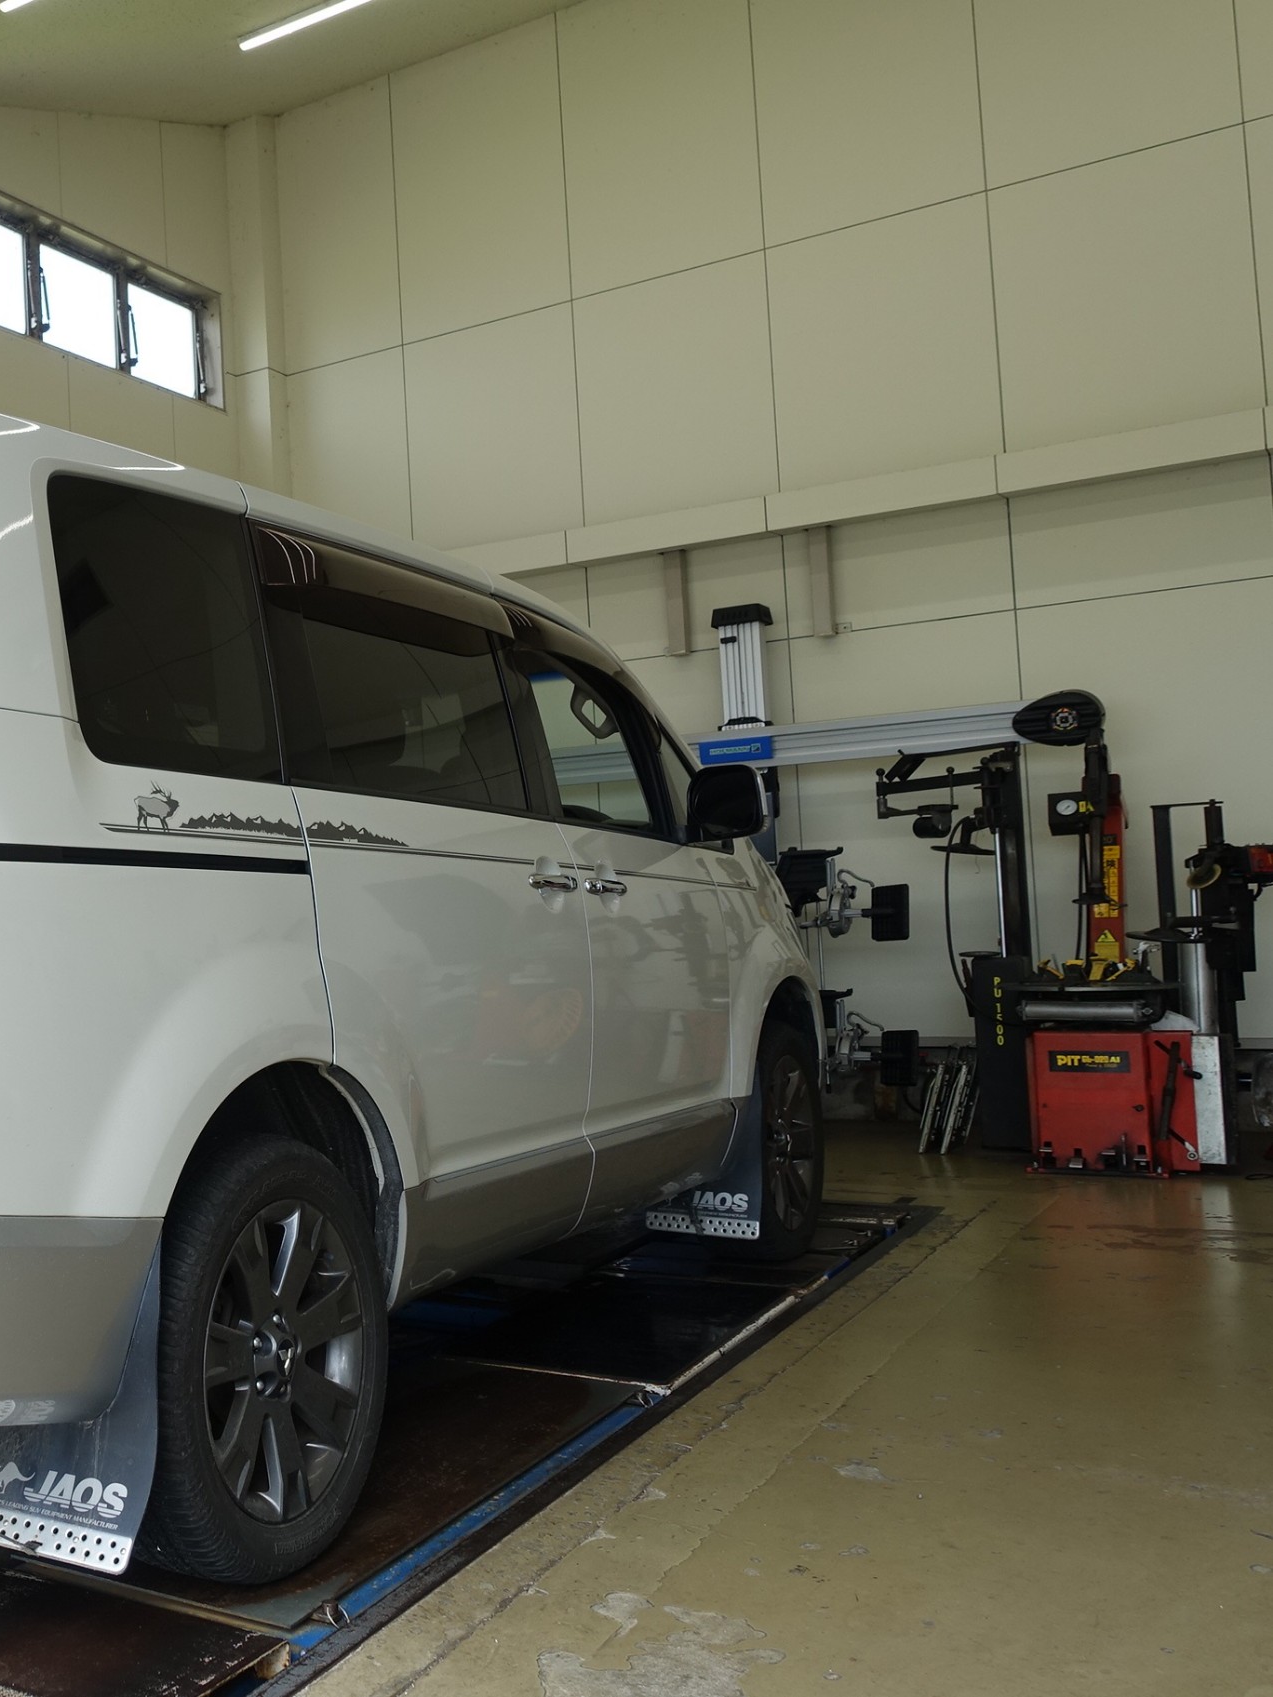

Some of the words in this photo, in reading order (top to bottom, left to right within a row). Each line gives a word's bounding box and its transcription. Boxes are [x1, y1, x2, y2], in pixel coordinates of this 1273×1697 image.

[993, 976, 1002, 998] PU
[1056, 1055, 1081, 1066] PIT
[23, 1470, 128, 1519] JAOS
[5, 1499, 29, 1512] LEADING
[29, 1506, 41, 1515] SUV
[40, 1508, 73, 1522] EQUIPMENT
[73, 1514, 119, 1531] MANUFACTURER
